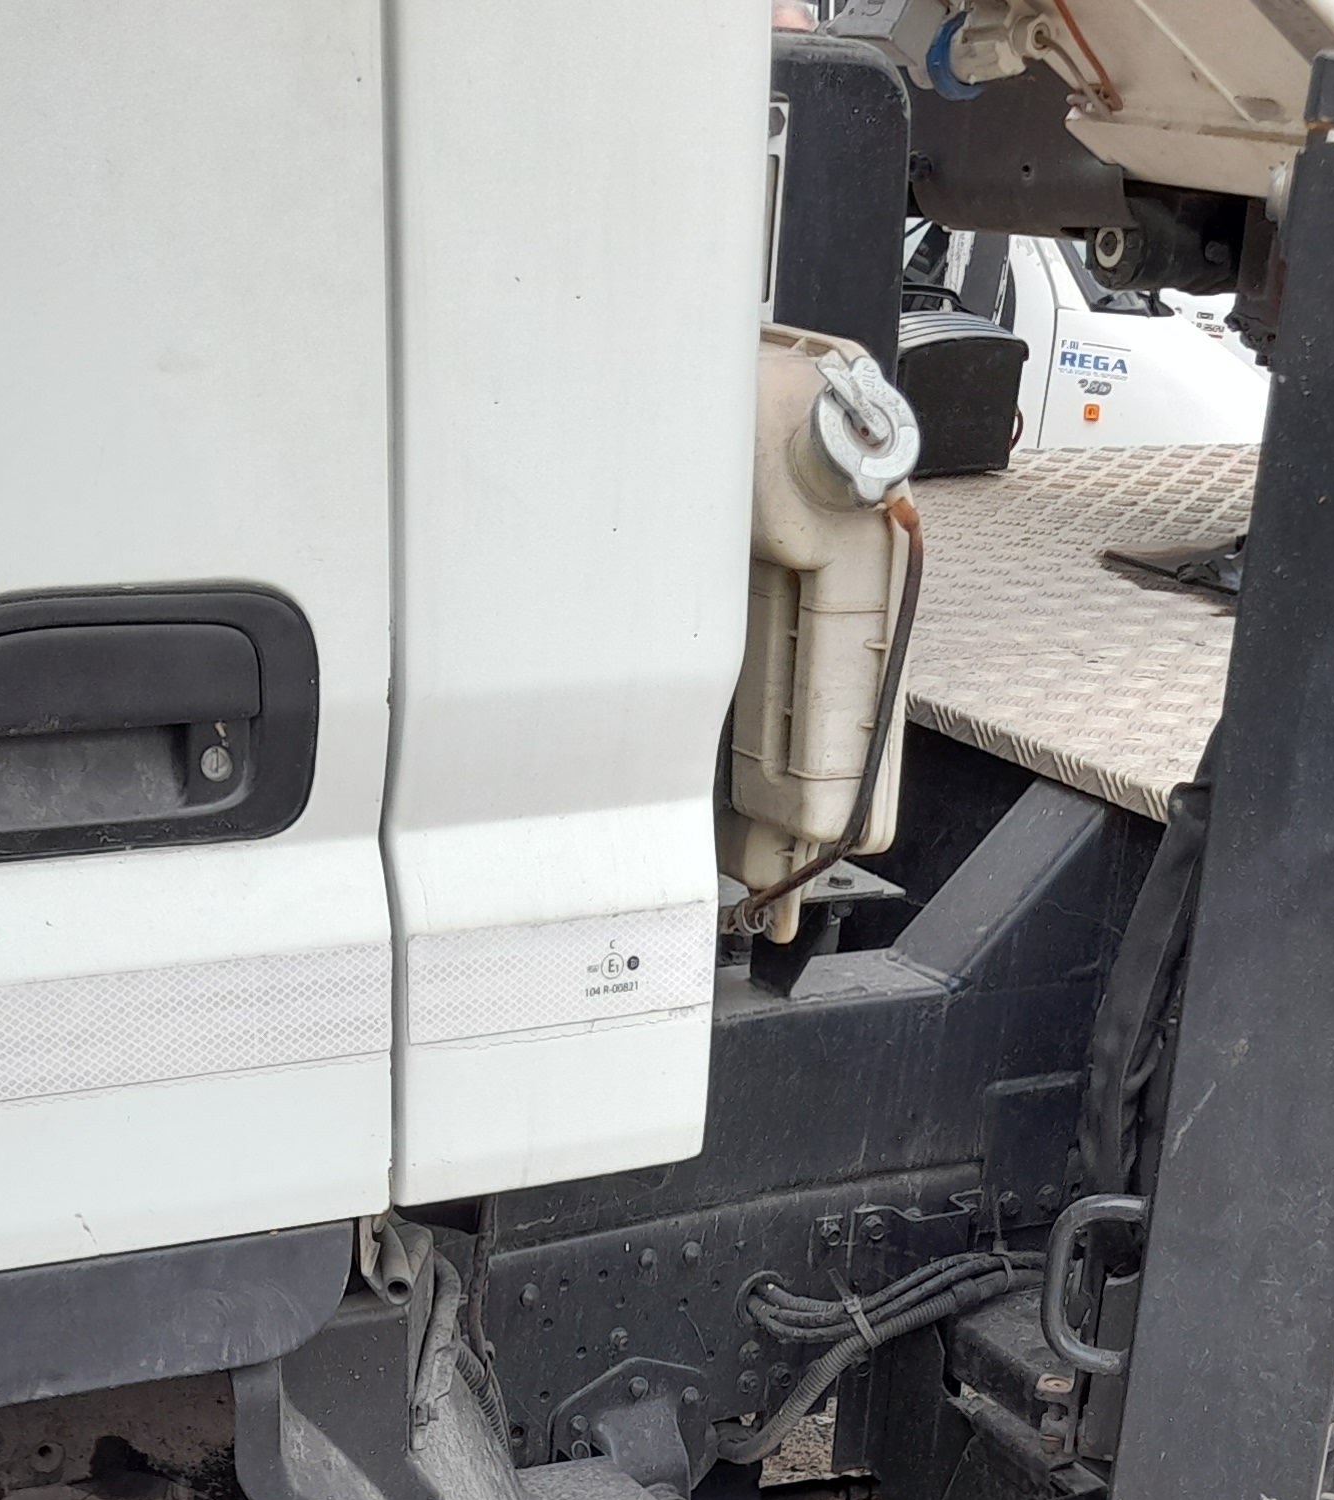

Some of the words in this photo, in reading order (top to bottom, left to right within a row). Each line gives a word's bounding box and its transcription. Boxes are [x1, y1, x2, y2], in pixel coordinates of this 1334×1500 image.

[1060, 351, 1128, 375] REGA
[609, 939, 617, 949] C
[585, 987, 601, 997] 104
[603, 981, 639, 994] R-00821
